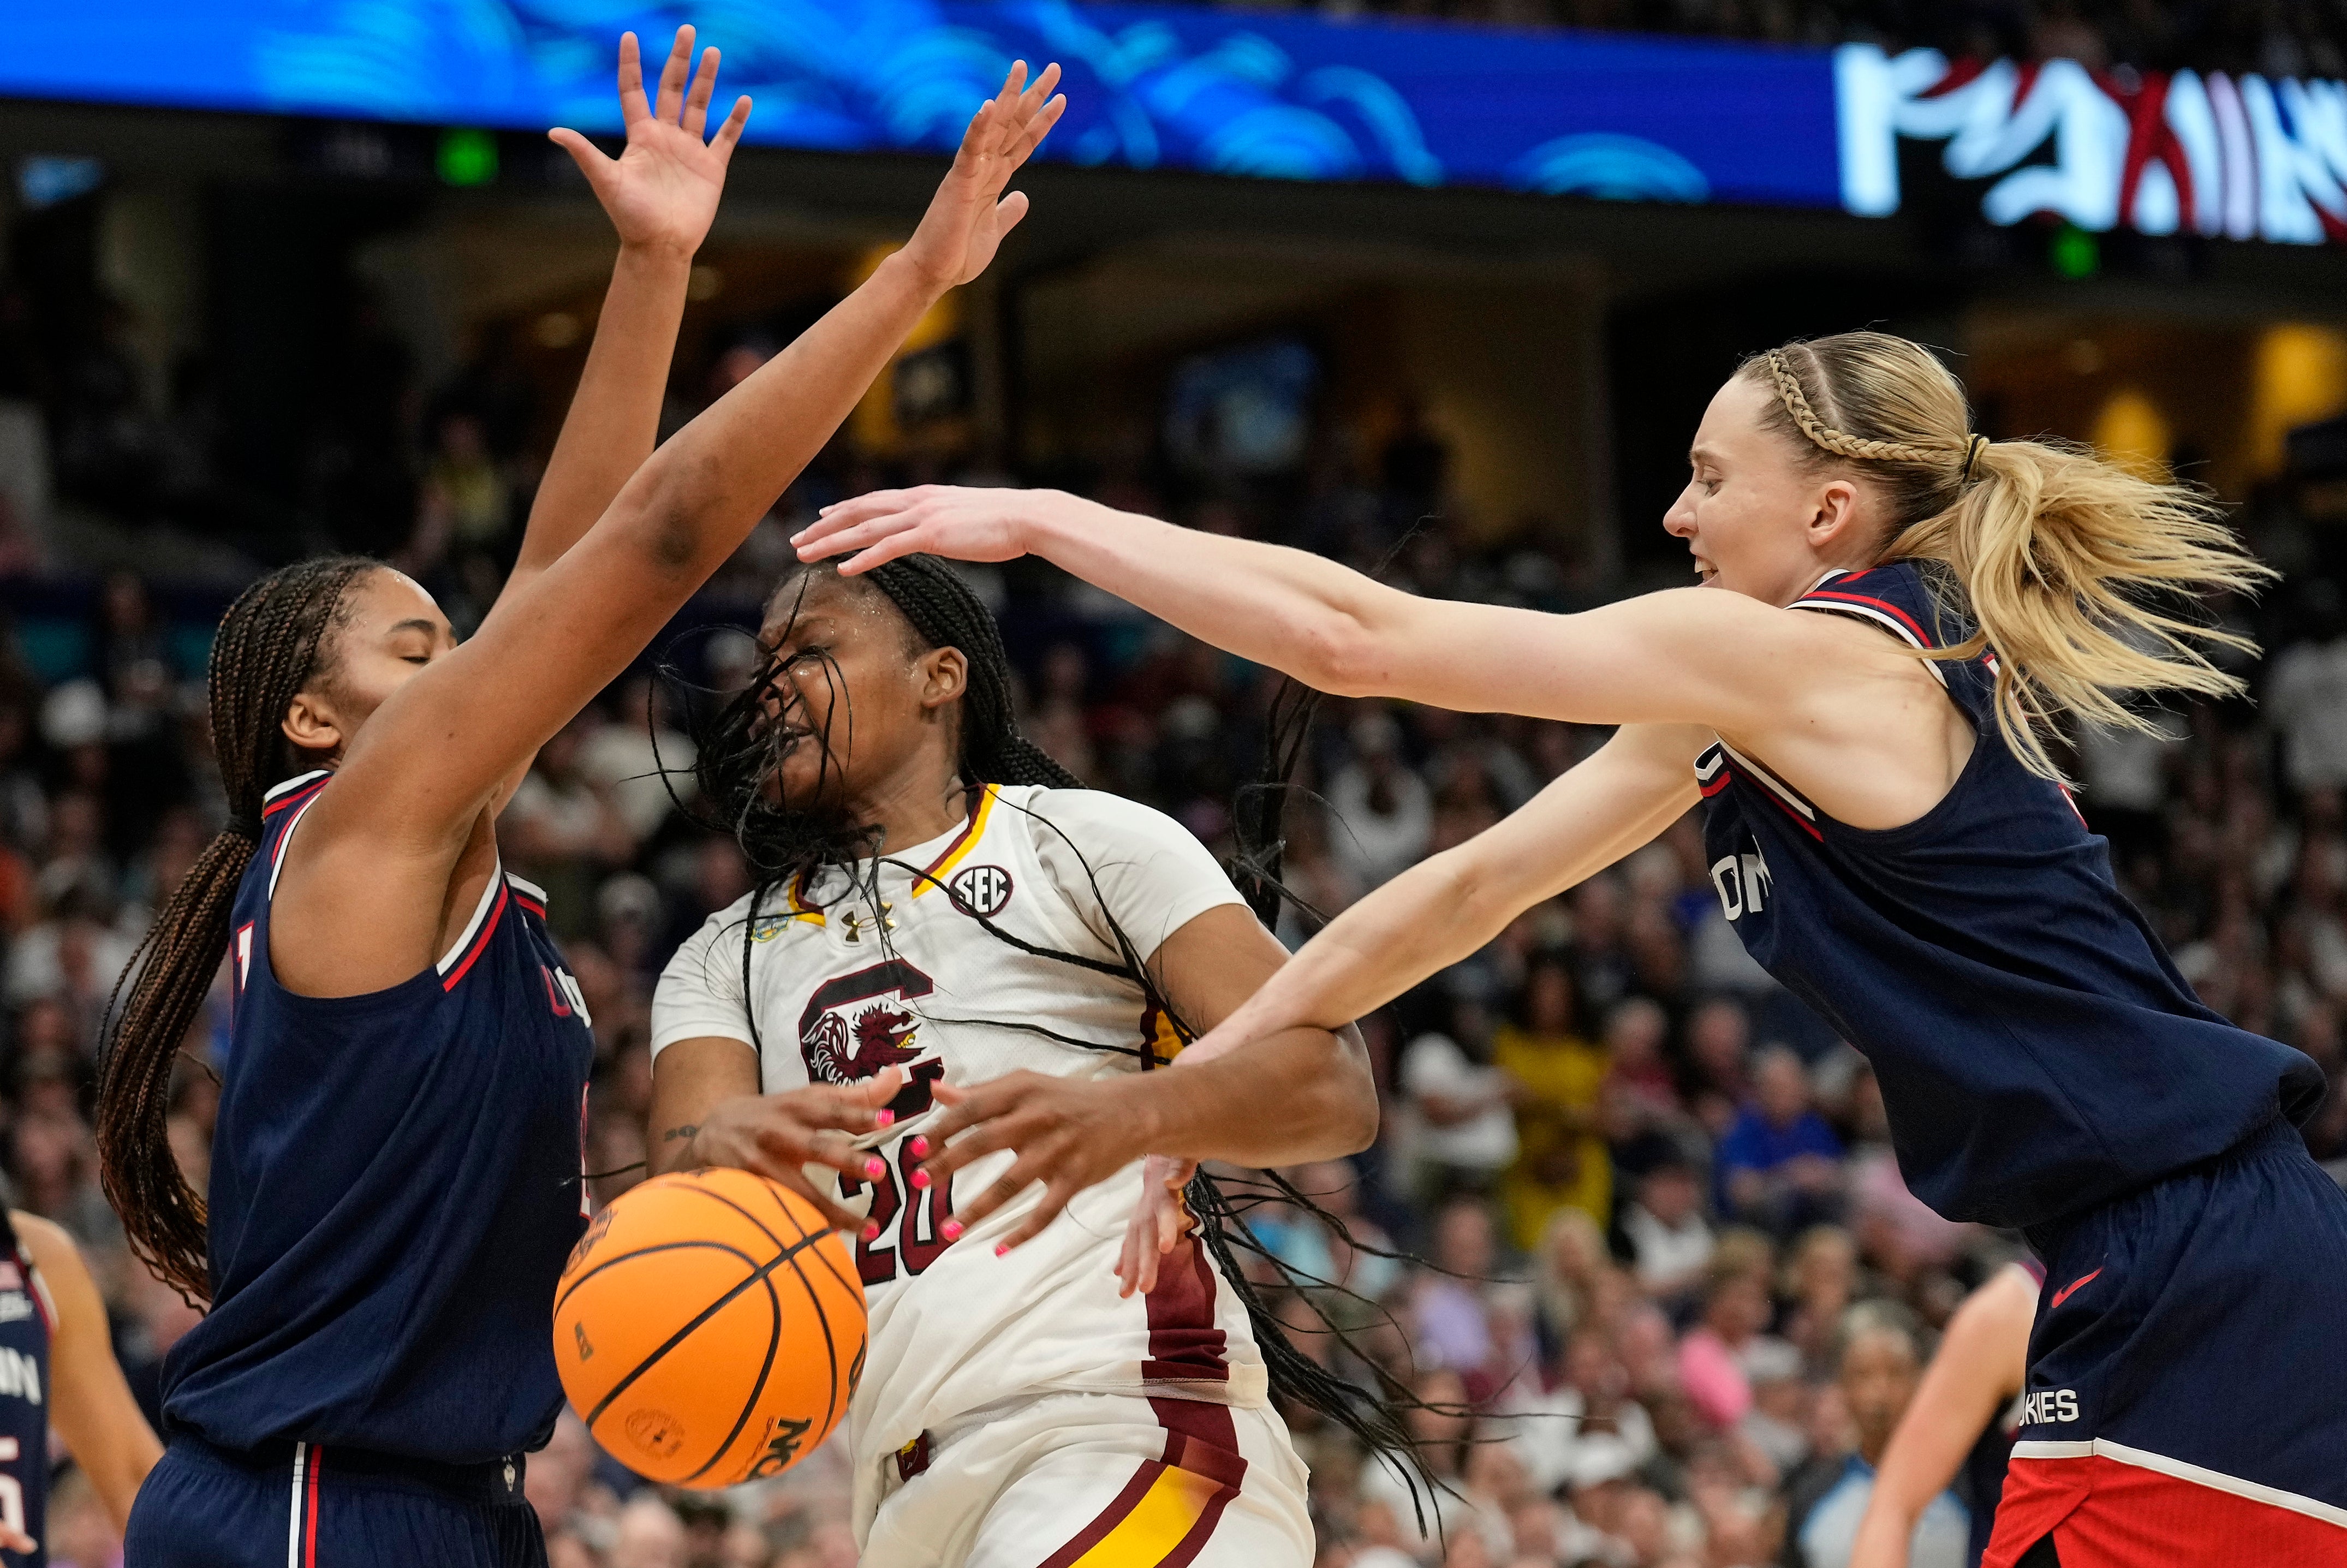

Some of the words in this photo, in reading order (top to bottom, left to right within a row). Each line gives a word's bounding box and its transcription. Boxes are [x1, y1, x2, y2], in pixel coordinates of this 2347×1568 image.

[955, 868, 1006, 913] SEC
[838, 1134, 959, 1286] 20
[2019, 1389, 2080, 1426] KIES
